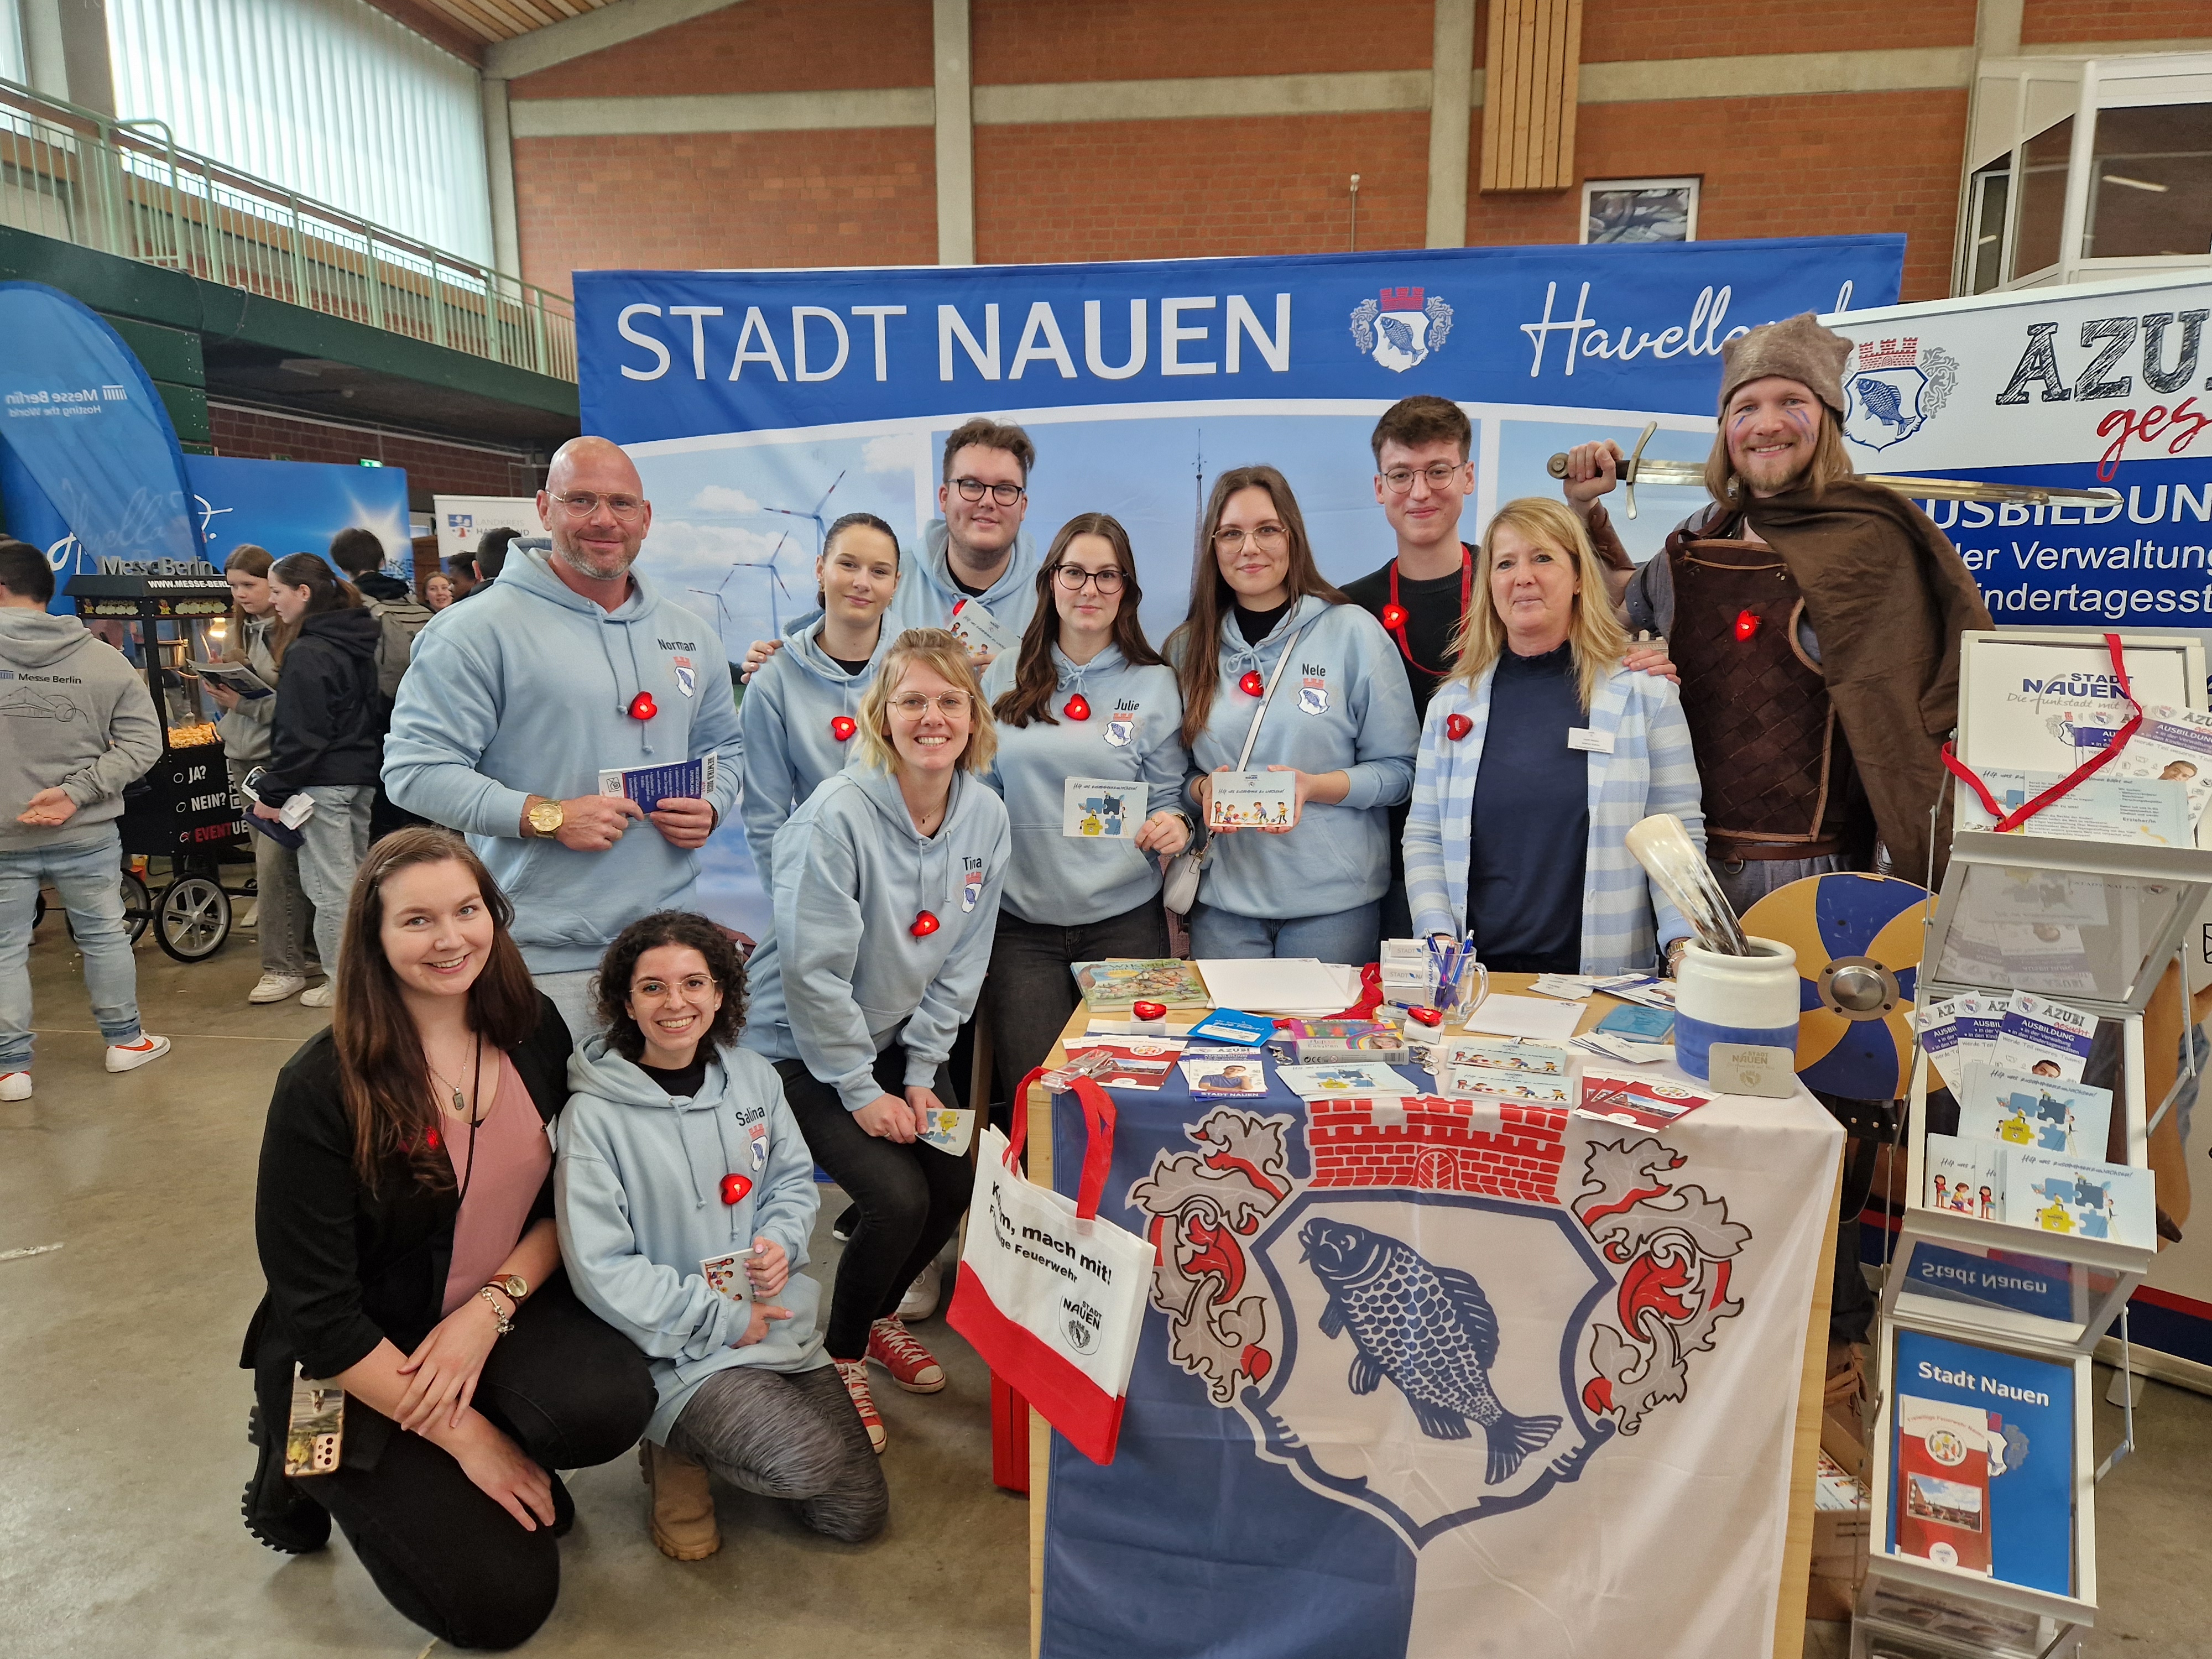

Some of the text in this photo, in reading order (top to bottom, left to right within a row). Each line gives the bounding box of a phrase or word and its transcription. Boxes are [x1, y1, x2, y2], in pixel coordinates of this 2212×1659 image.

[617, 293, 1290, 382] STADT NAUEN
[1520, 280, 1853, 377] Havell
[1995, 308, 2212, 405] AZU
[1924, 483, 2212, 529] USBILDUN
[97, 556, 215, 576] Messe Berlin
[2011, 539, 2212, 575] Verwaltun
[1976, 582, 2212, 619] indertagesst
[658, 638, 696, 653] Norman
[18, 673, 81, 684] Messe Berlin
[1302, 663, 1326, 677] Nele
[2023, 679, 2131, 700] NAUEN
[1114, 698, 1140, 712] Julie
[2006, 692, 2027, 702] Die
[2098, 701, 2120, 709] mit
[2182, 712, 2212, 727] AZU
[188, 765, 206, 784] JA?
[191, 792, 226, 811] NEIN?
[962, 855, 982, 871] Tina
[1973, 1020, 2001, 1028] AUSBIL
[2042, 1004, 2086, 1027] AZUBI
[1933, 1025, 1957, 1037] AUSBI
[2021, 1019, 2075, 1041] AUSBILDUNG
[2041, 1032, 2072, 1048] Verwaltung
[1732, 1053, 1768, 1065] NAUEN
[1990, 1068, 2005, 1079] Hilf
[735, 1107, 765, 1127] Salina
[1940, 1157, 1955, 1167] Hilf
[2021, 1154, 2035, 1164] Hilf
[1014, 1244, 1078, 1284] Feuerwehr
[1022, 1225, 1076, 1260] mach
[1079, 1254, 1113, 1286] mit!
[1063, 1297, 1100, 1331] NAUEN
[1082, 1300, 1103, 1319] STADT
[1918, 1361, 2049, 1407] Stadt Nauen
